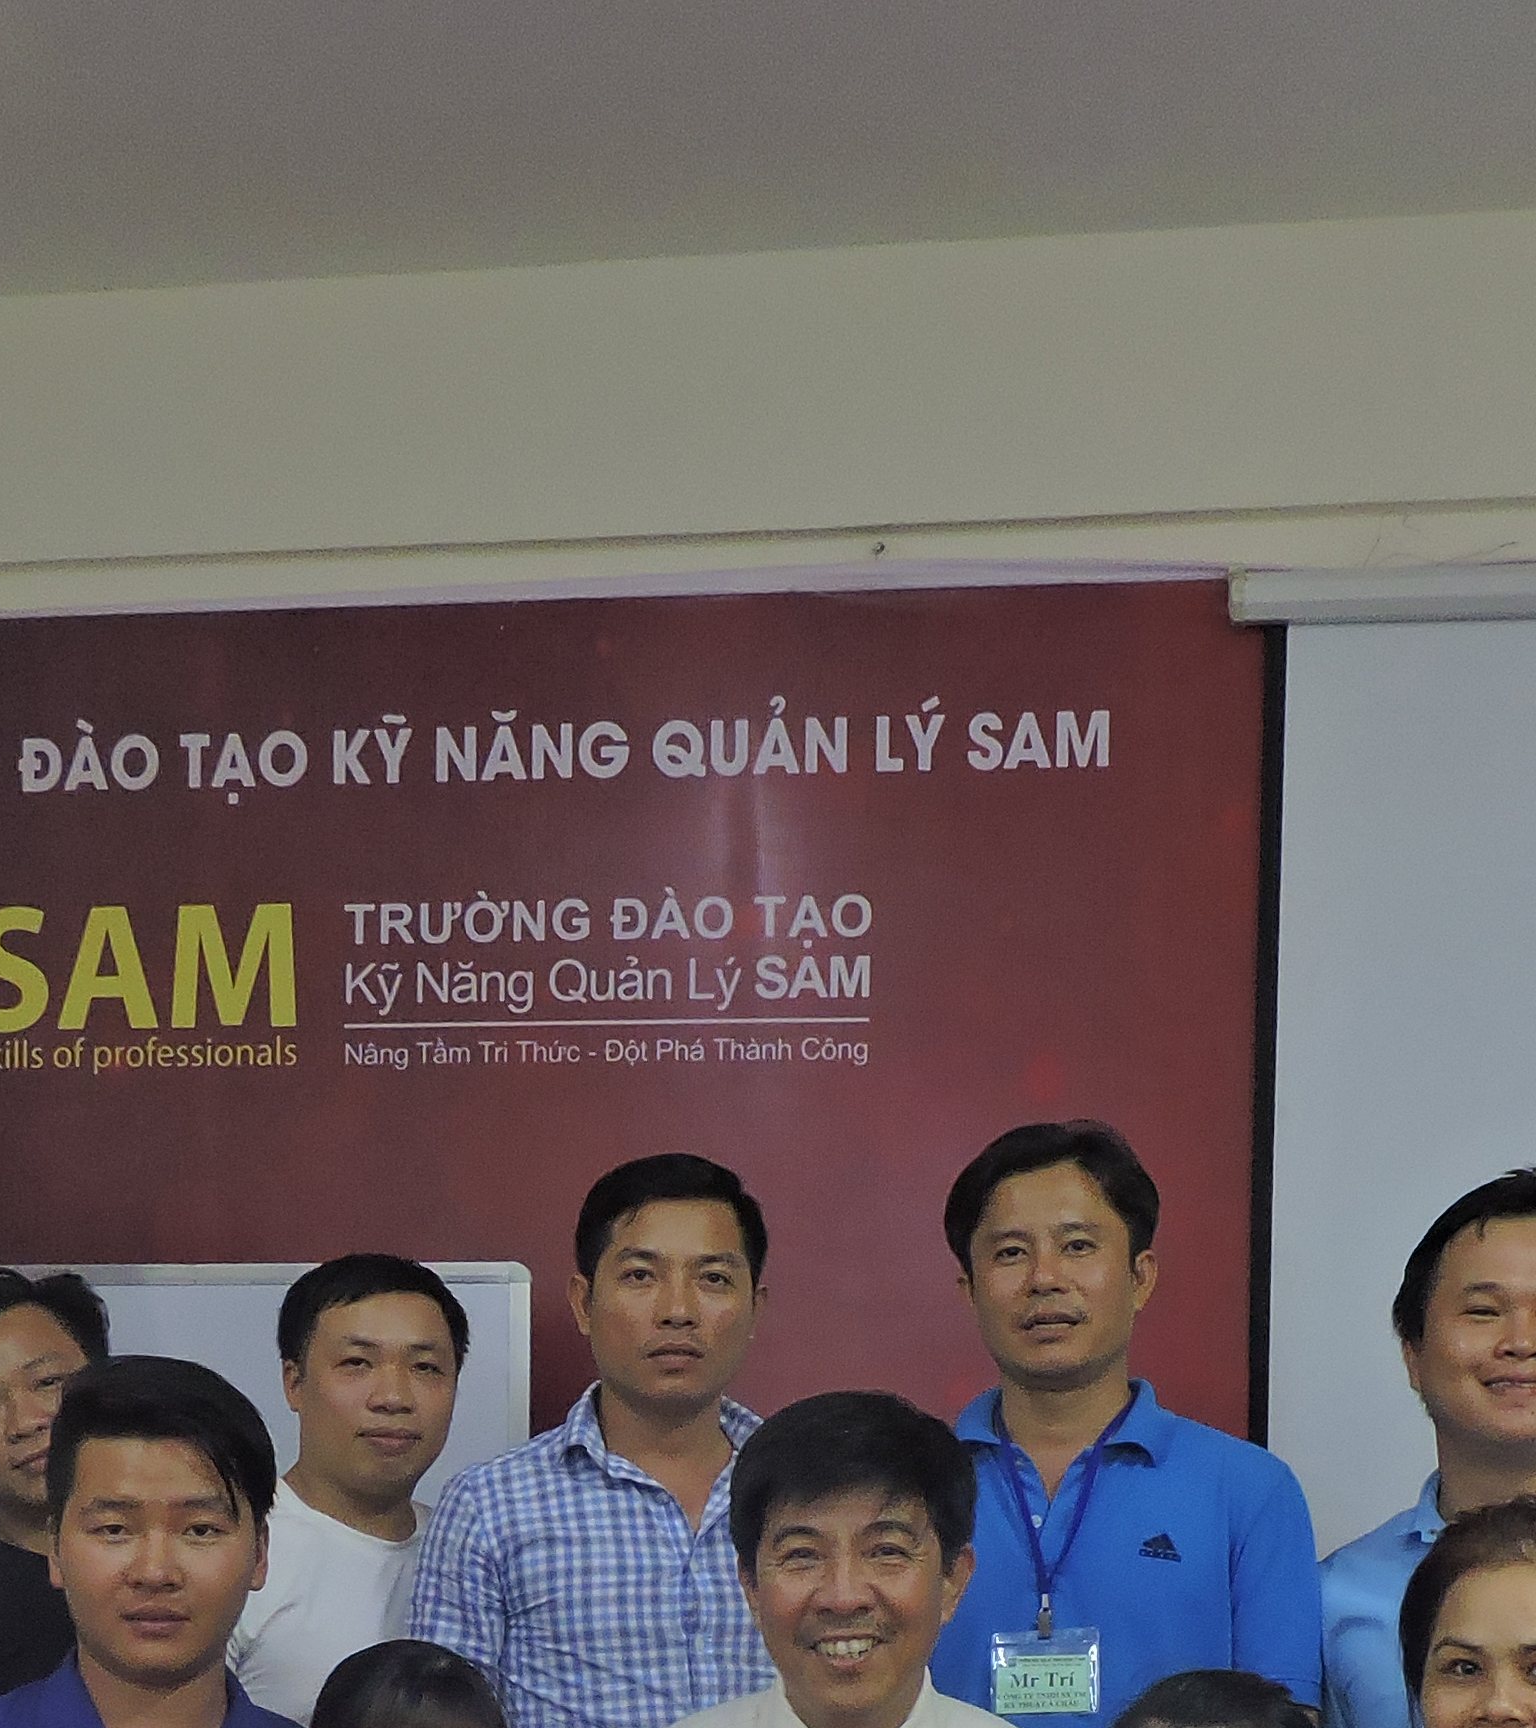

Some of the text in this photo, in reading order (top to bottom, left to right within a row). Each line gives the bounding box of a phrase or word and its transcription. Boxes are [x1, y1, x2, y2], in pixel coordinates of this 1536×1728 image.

[19, 718, 160, 793] ĐÀO
[179, 730, 308, 805] TẠO
[333, 714, 412, 785] KỸ
[436, 709, 630, 783] NĂNG
[651, 695, 848, 778] QUẢN
[875, 696, 946, 772] LÝ
[967, 710, 1111, 771] SAM
[344, 886, 873, 949] TRƯỜNG ĐÀO TẠO
[345, 955, 871, 1016] Kỹ Năng Quản Lý SAM
[53, 1037, 85, 1068] of
[94, 1035, 297, 1075] professionals
[345, 1042, 409, 1070] Nâng
[478, 1040, 509, 1064] Tri
[516, 1039, 581, 1064] Thức
[605, 1039, 648, 1066] Đột
[656, 1038, 706, 1062] Phá
[714, 1037, 792, 1062] Thành
[801, 1037, 869, 1066] Công
[1010, 1671, 1075, 1688] Mr Trí
